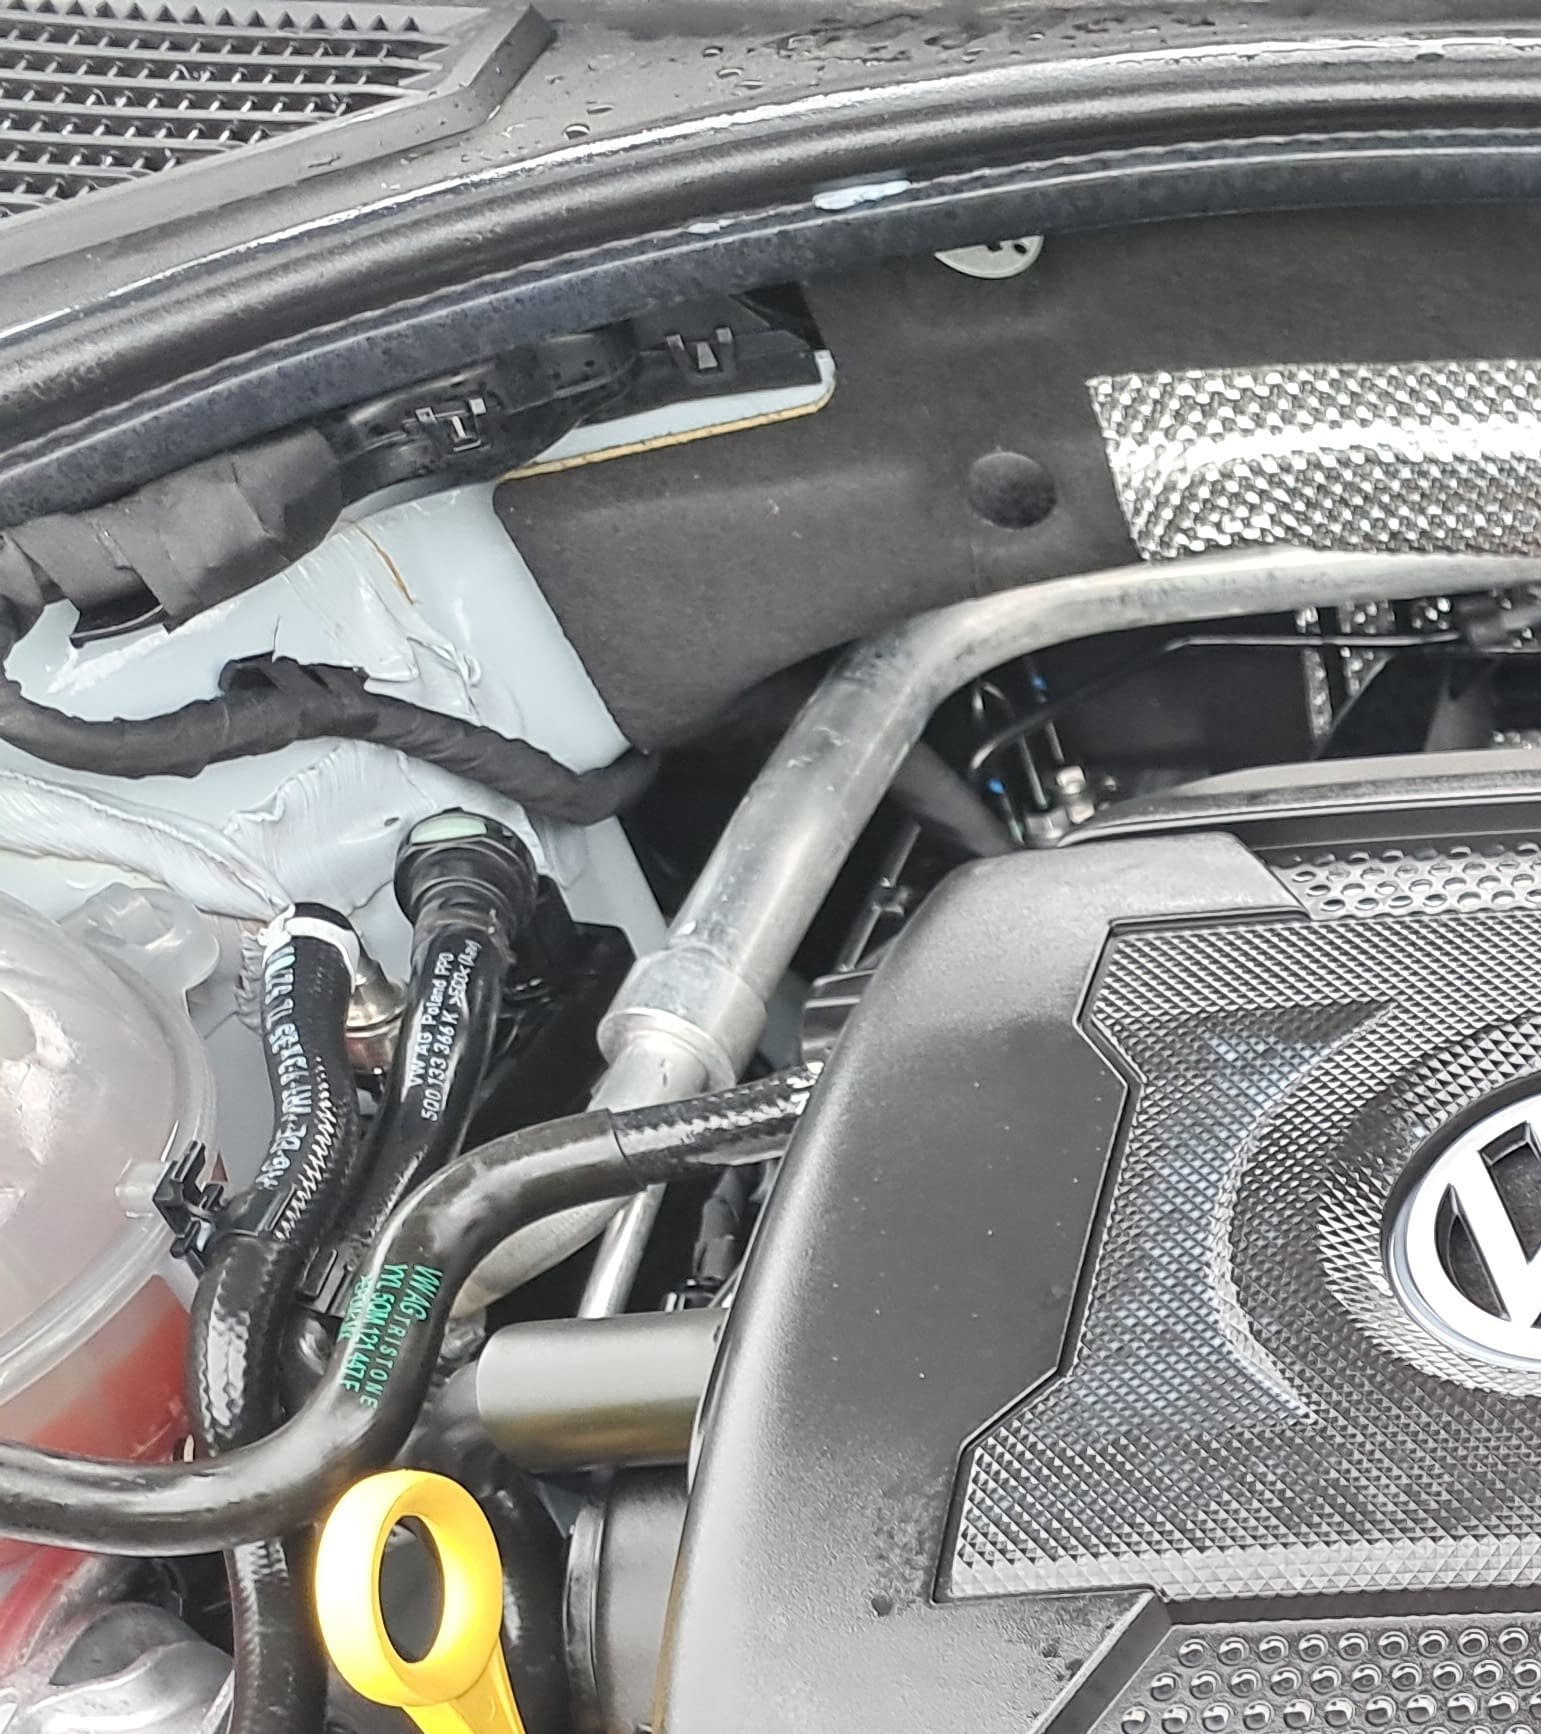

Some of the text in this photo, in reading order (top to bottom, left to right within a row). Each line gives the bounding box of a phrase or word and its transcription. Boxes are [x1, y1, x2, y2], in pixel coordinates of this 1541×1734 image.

[422, 978, 447, 1025] Poland
[440, 1008, 458, 1023] K
[415, 1030, 433, 1055] AG
[433, 1023, 455, 1054] 366
[408, 1058, 428, 1086] VW
[428, 1056, 447, 1084] 133
[363, 1292, 395, 1325] 5QM
[352, 1328, 381, 1350] 121
[358, 1314, 406, 1408] TRISTONE
